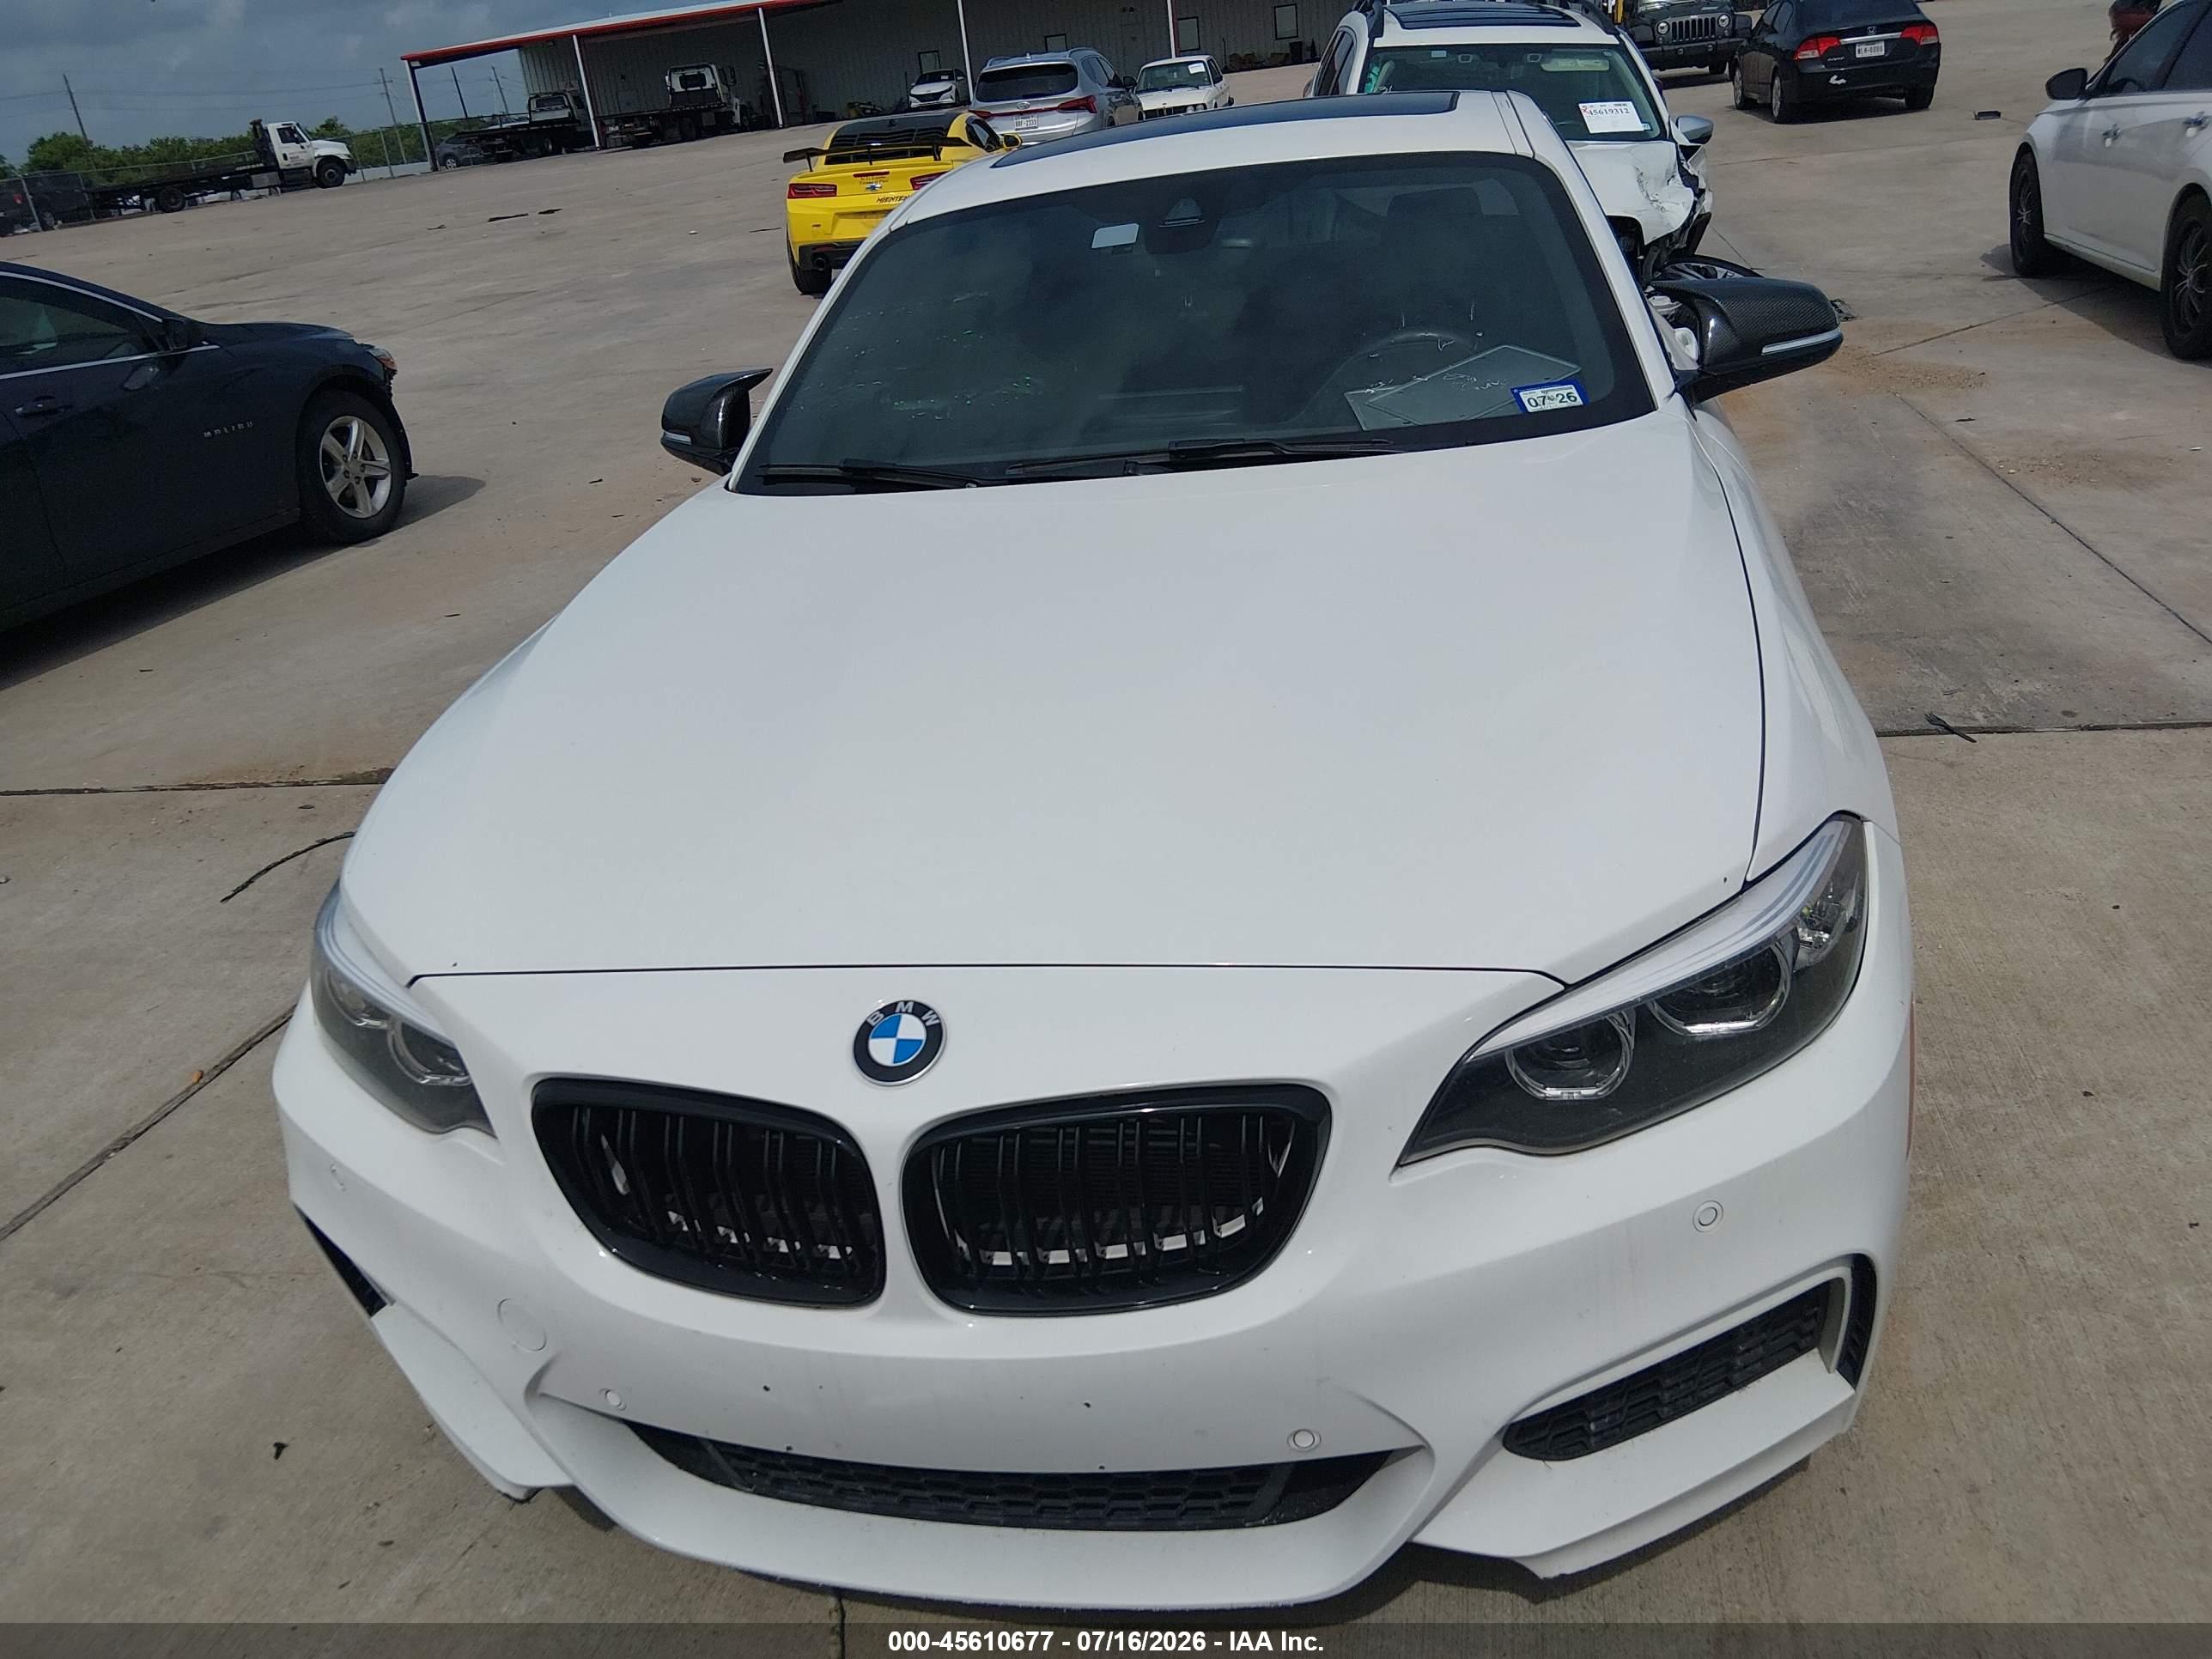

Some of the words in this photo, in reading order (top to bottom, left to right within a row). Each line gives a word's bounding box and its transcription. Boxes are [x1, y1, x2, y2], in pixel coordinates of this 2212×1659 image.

[1527, 395, 1547, 408] 07
[1555, 392, 1577, 404] 26
[203, 421, 253, 438] MALIBU
[866, 1000, 942, 1027] BMW
